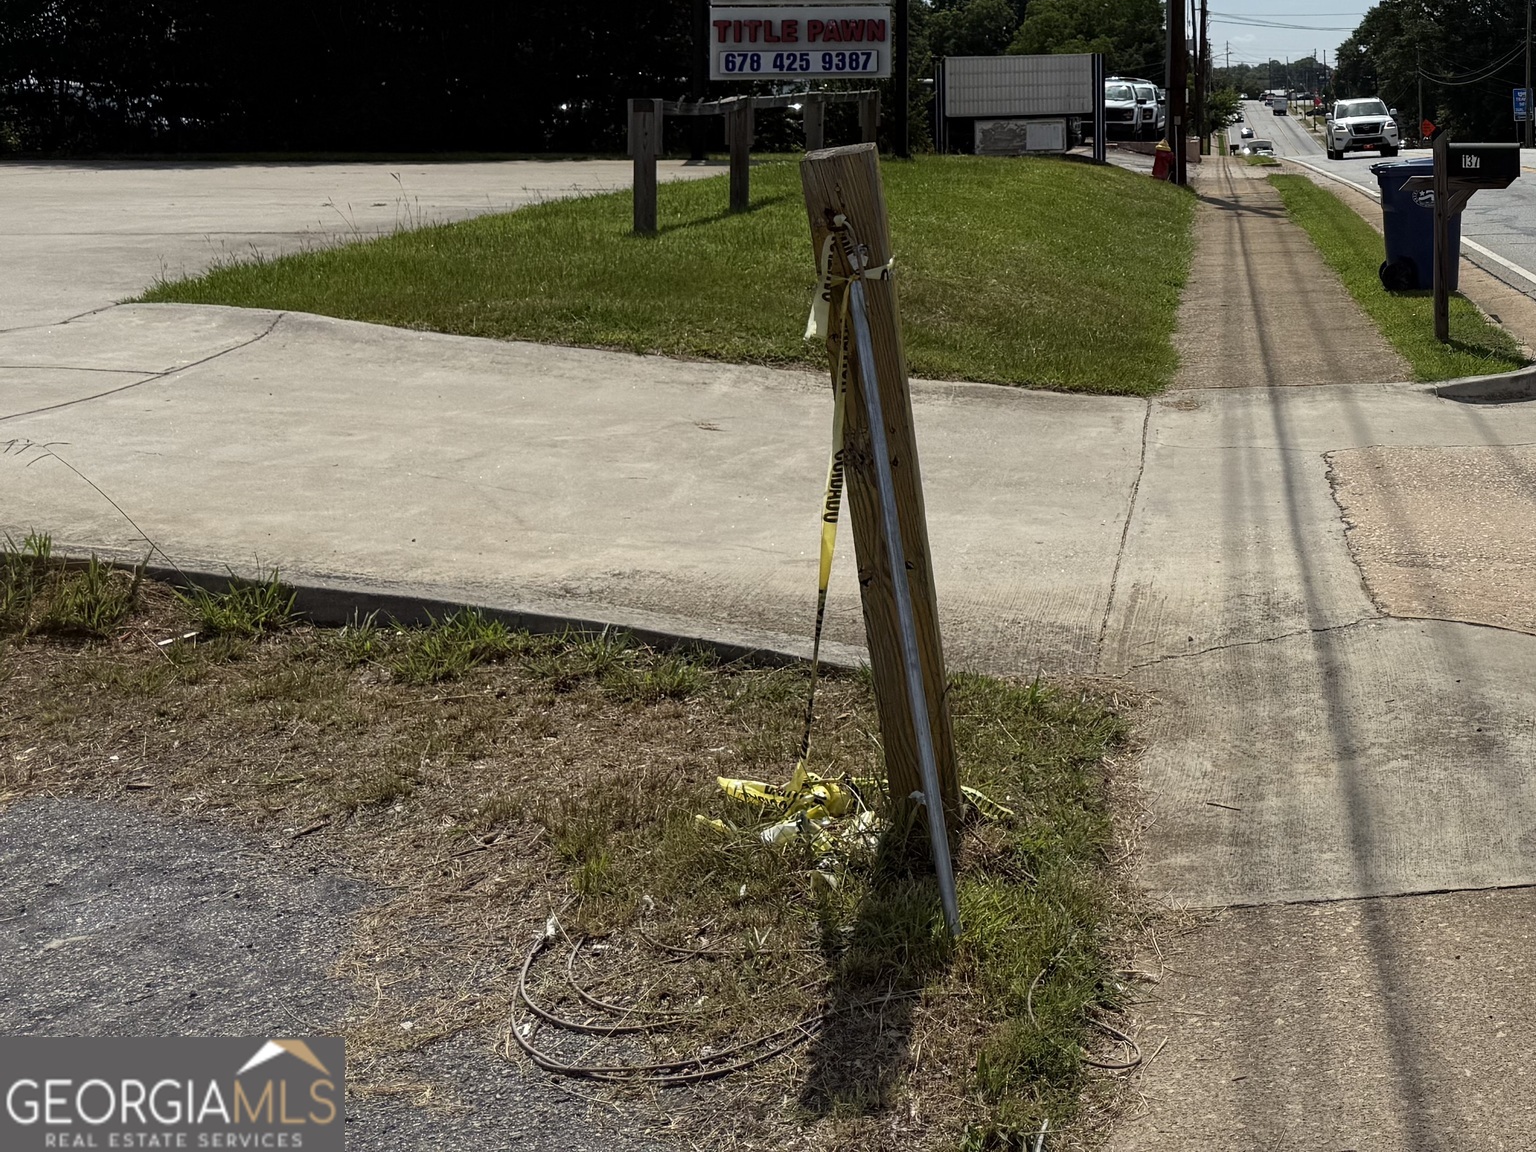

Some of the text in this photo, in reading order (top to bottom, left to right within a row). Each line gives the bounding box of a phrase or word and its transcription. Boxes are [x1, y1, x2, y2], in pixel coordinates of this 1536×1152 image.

[713, 19, 886, 43] TITLE PAWN
[724, 51, 872, 72] 678 425 9387
[1462, 154, 1480, 168] 137
